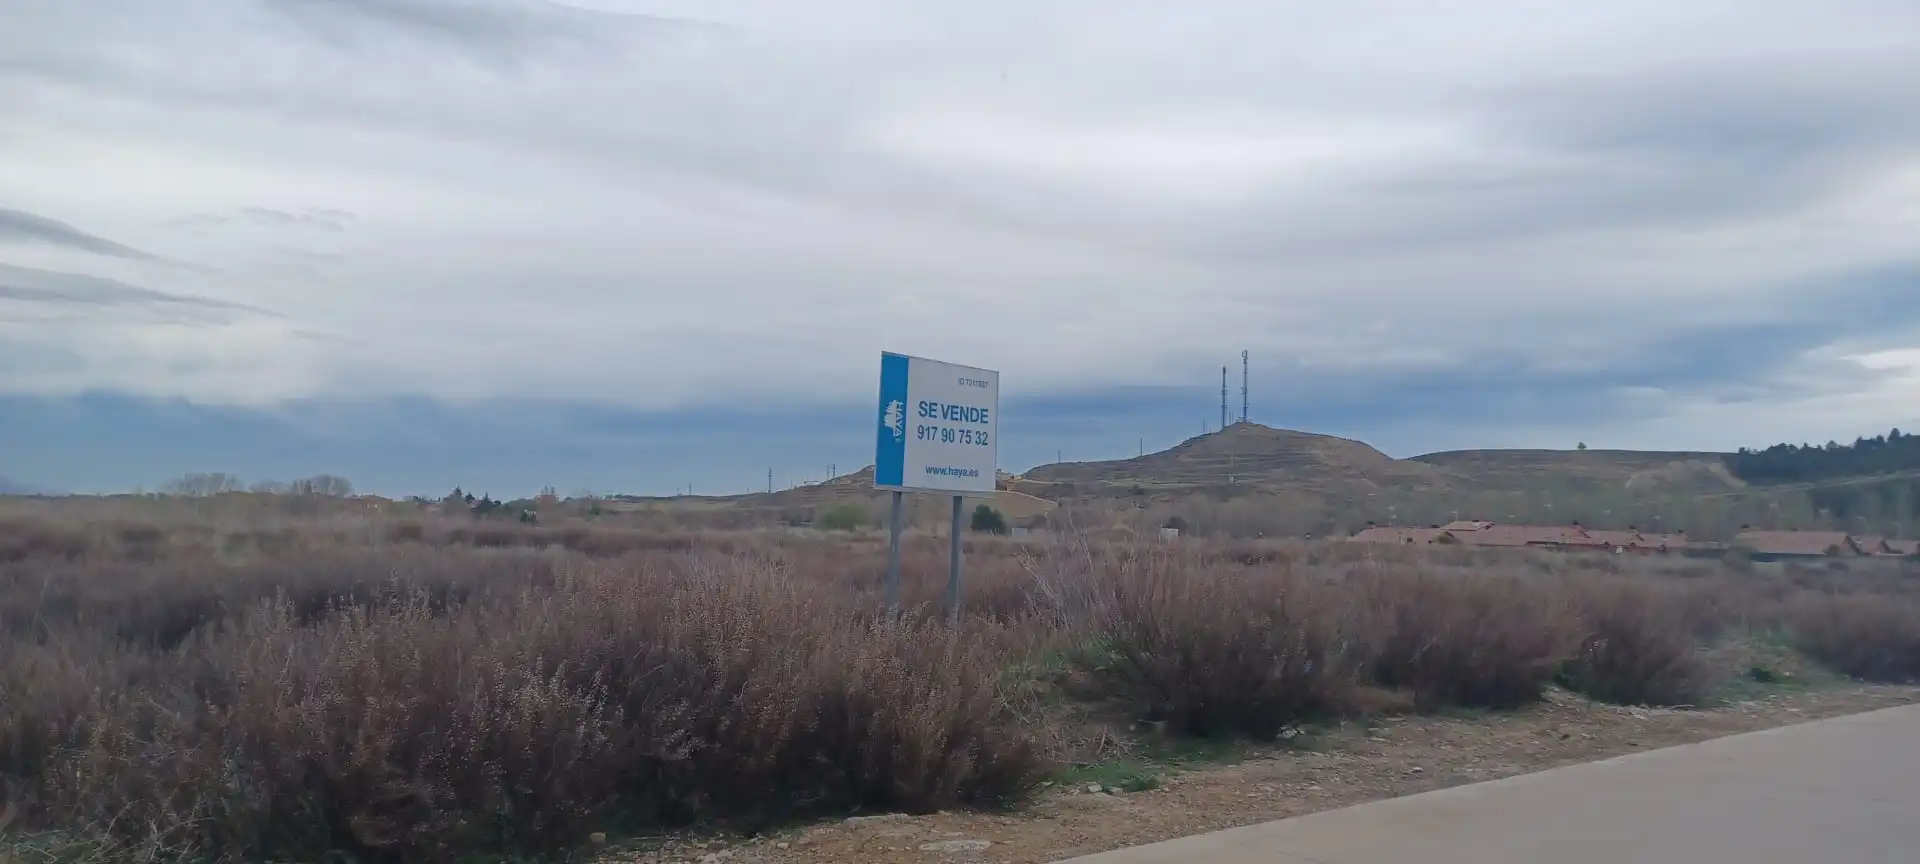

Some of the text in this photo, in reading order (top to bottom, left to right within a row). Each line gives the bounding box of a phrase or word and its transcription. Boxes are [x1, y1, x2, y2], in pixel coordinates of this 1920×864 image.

[894, 401, 904, 437] HAYA
[918, 401, 988, 424] SE VENDE
[918, 425, 988, 446] 917 90 75 32
[926, 466, 978, 478] www.haya.es
